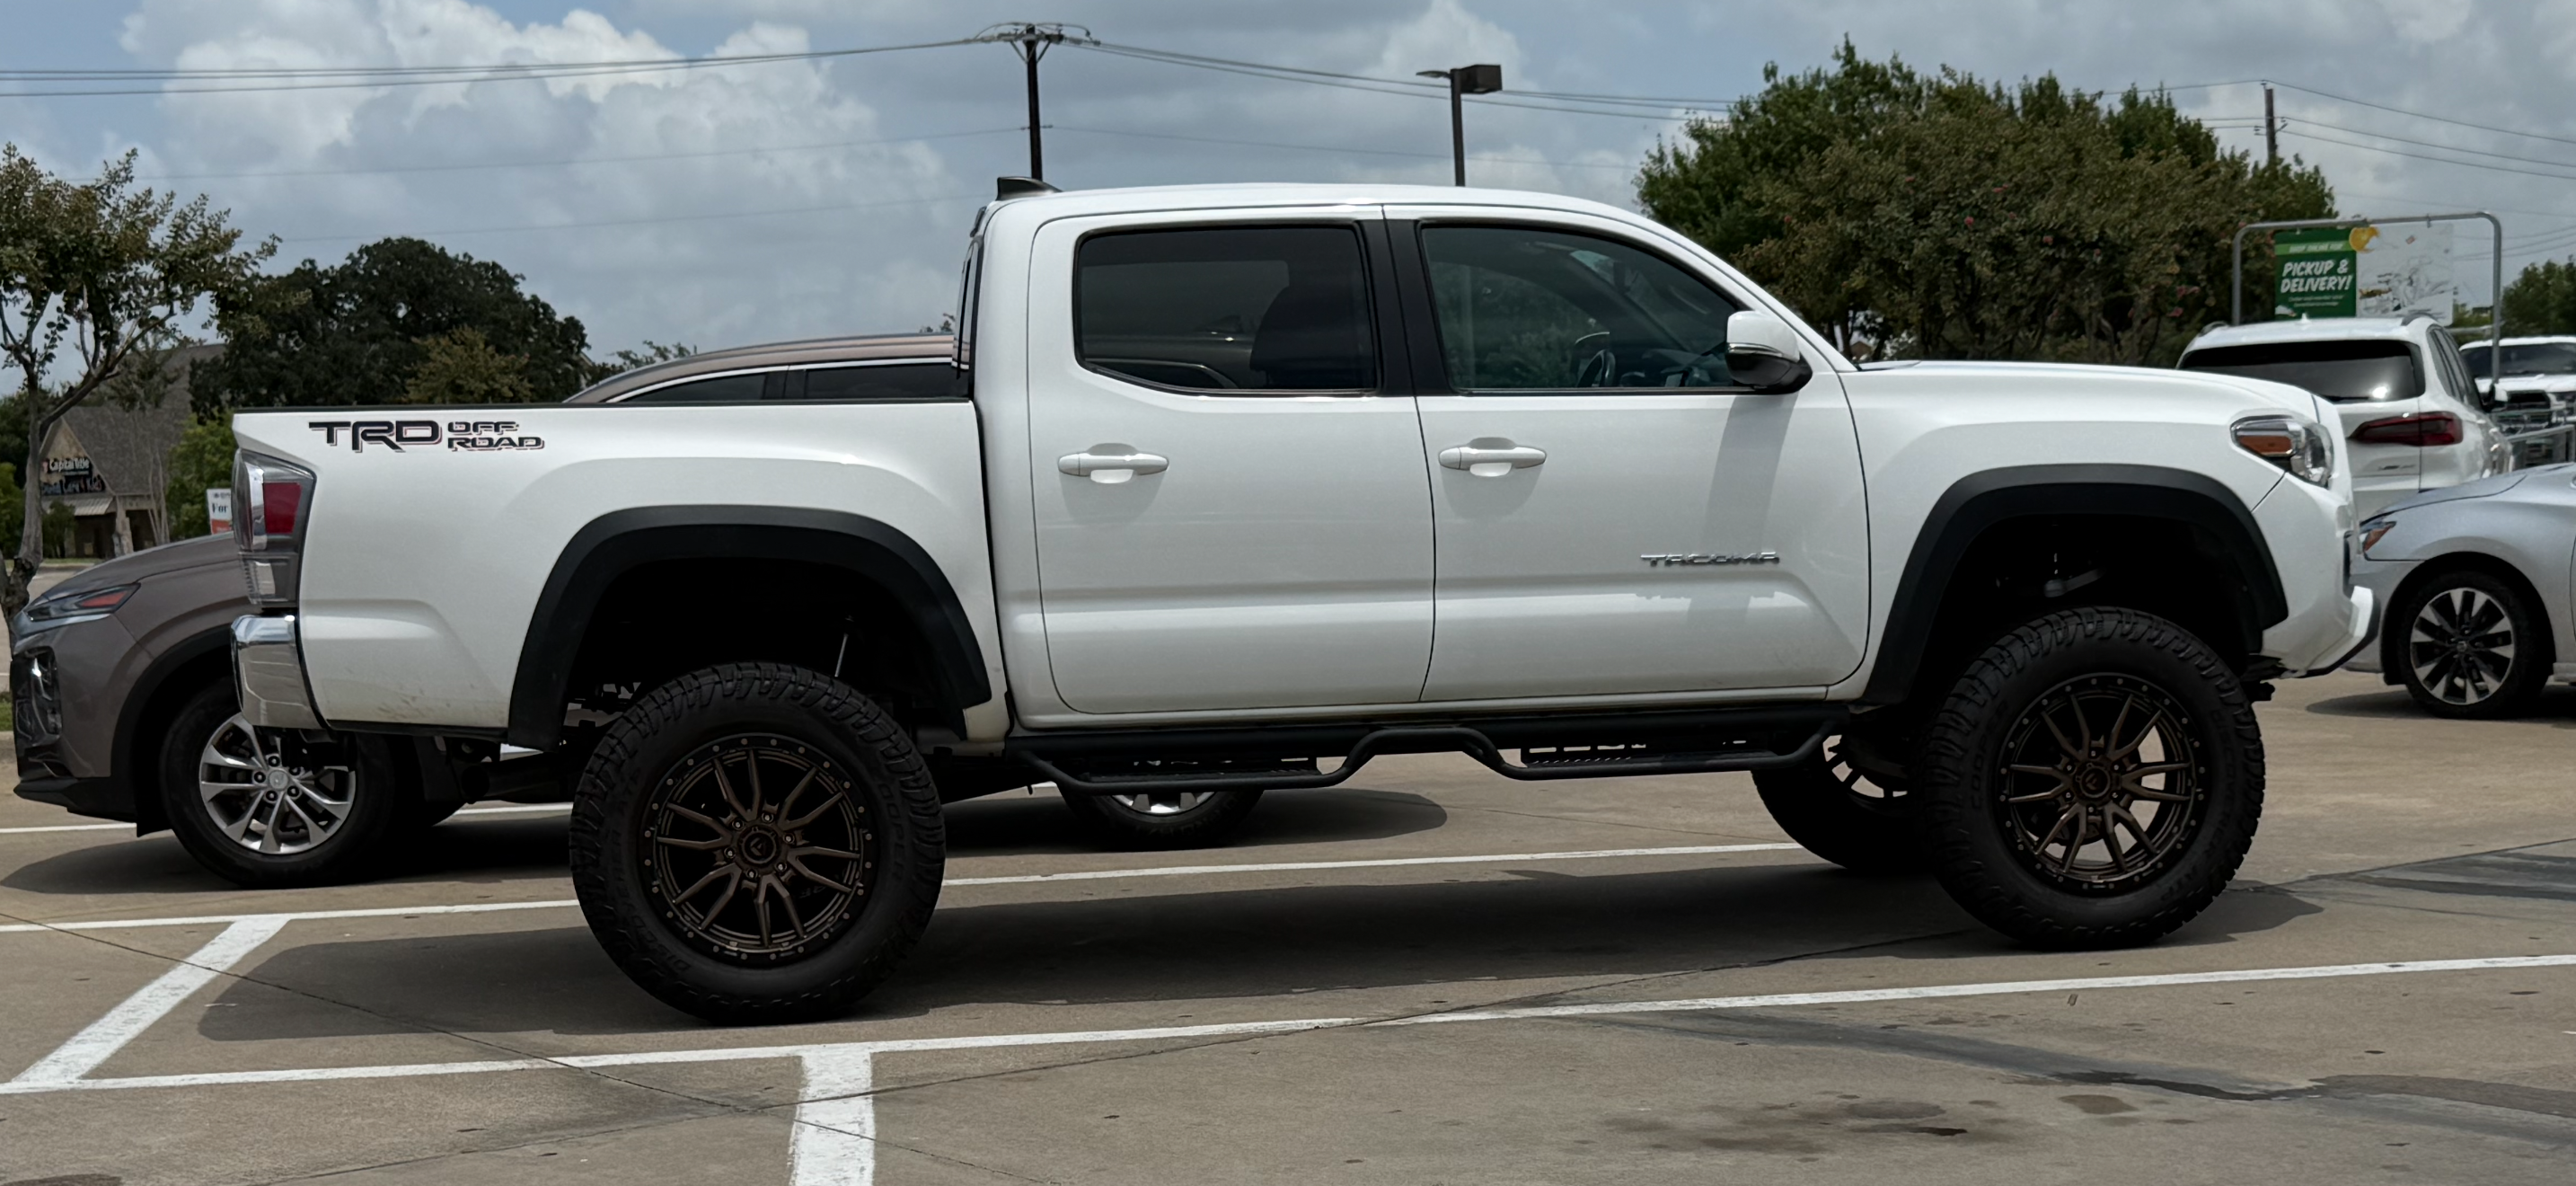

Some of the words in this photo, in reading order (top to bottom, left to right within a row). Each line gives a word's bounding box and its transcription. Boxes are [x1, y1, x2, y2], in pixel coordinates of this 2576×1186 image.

[2282, 260, 2334, 277] PICKUP
[2337, 259, 2348, 274] &
[2280, 275, 2352, 293] DELIVERY!
[448, 421, 520, 435] OFF
[309, 420, 442, 453] TRD
[448, 437, 545, 452] ROAD
[49, 458, 75, 473] Capital
[1640, 551, 1780, 567] TACOMA
